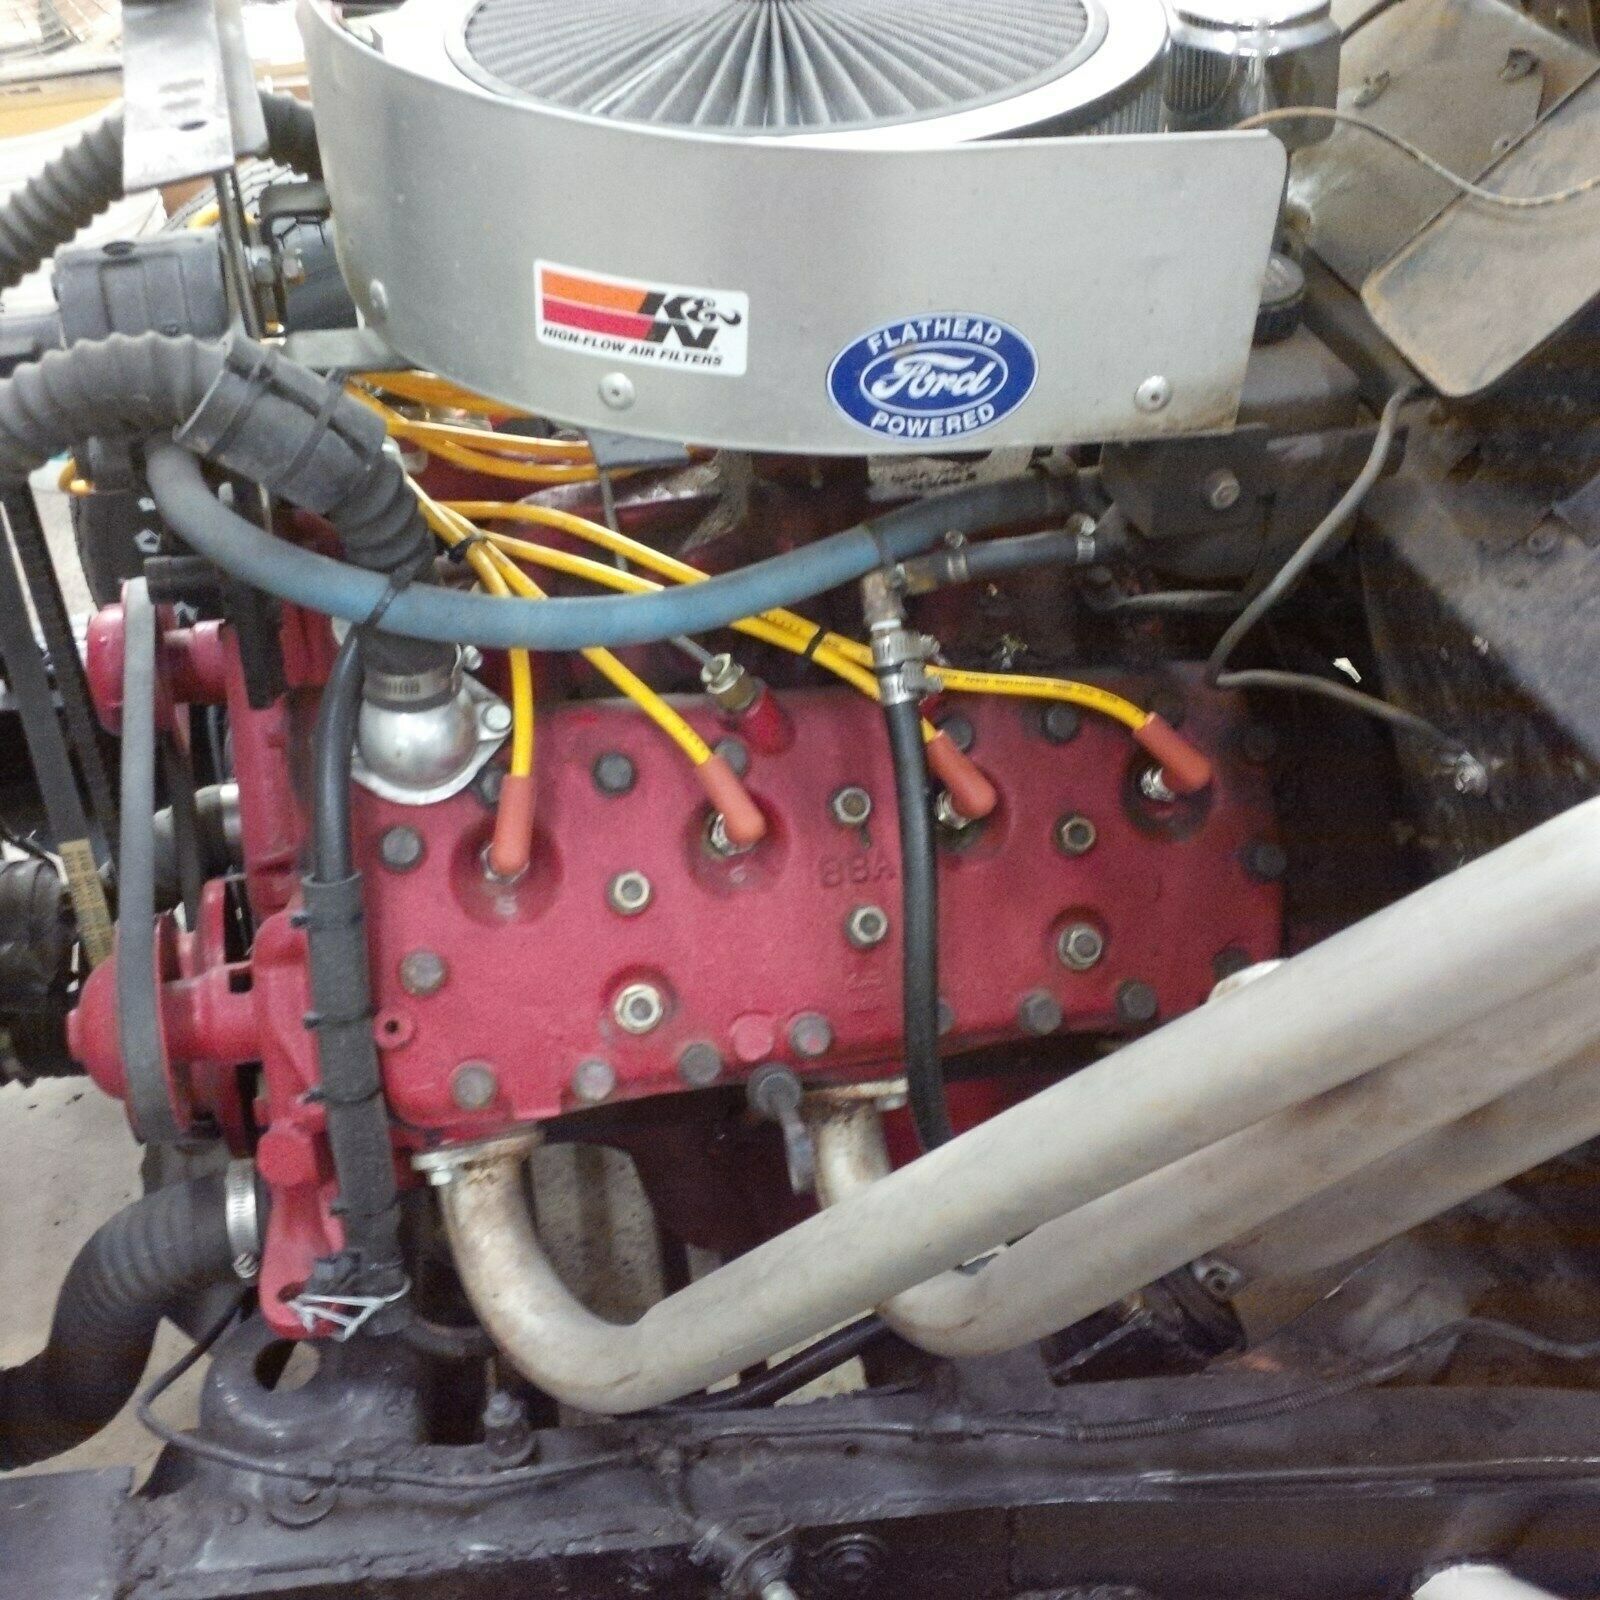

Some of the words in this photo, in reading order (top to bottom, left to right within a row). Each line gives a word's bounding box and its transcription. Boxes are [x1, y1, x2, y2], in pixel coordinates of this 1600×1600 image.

[638, 291, 742, 350] K&N
[867, 317, 1003, 355] FLATHEAD
[543, 326, 625, 353] HIGH-FLOW
[628, 343, 656, 358] AIR
[659, 349, 724, 367] FILTERS
[870, 351, 998, 400] Ford
[869, 402, 996, 438] POWERED
